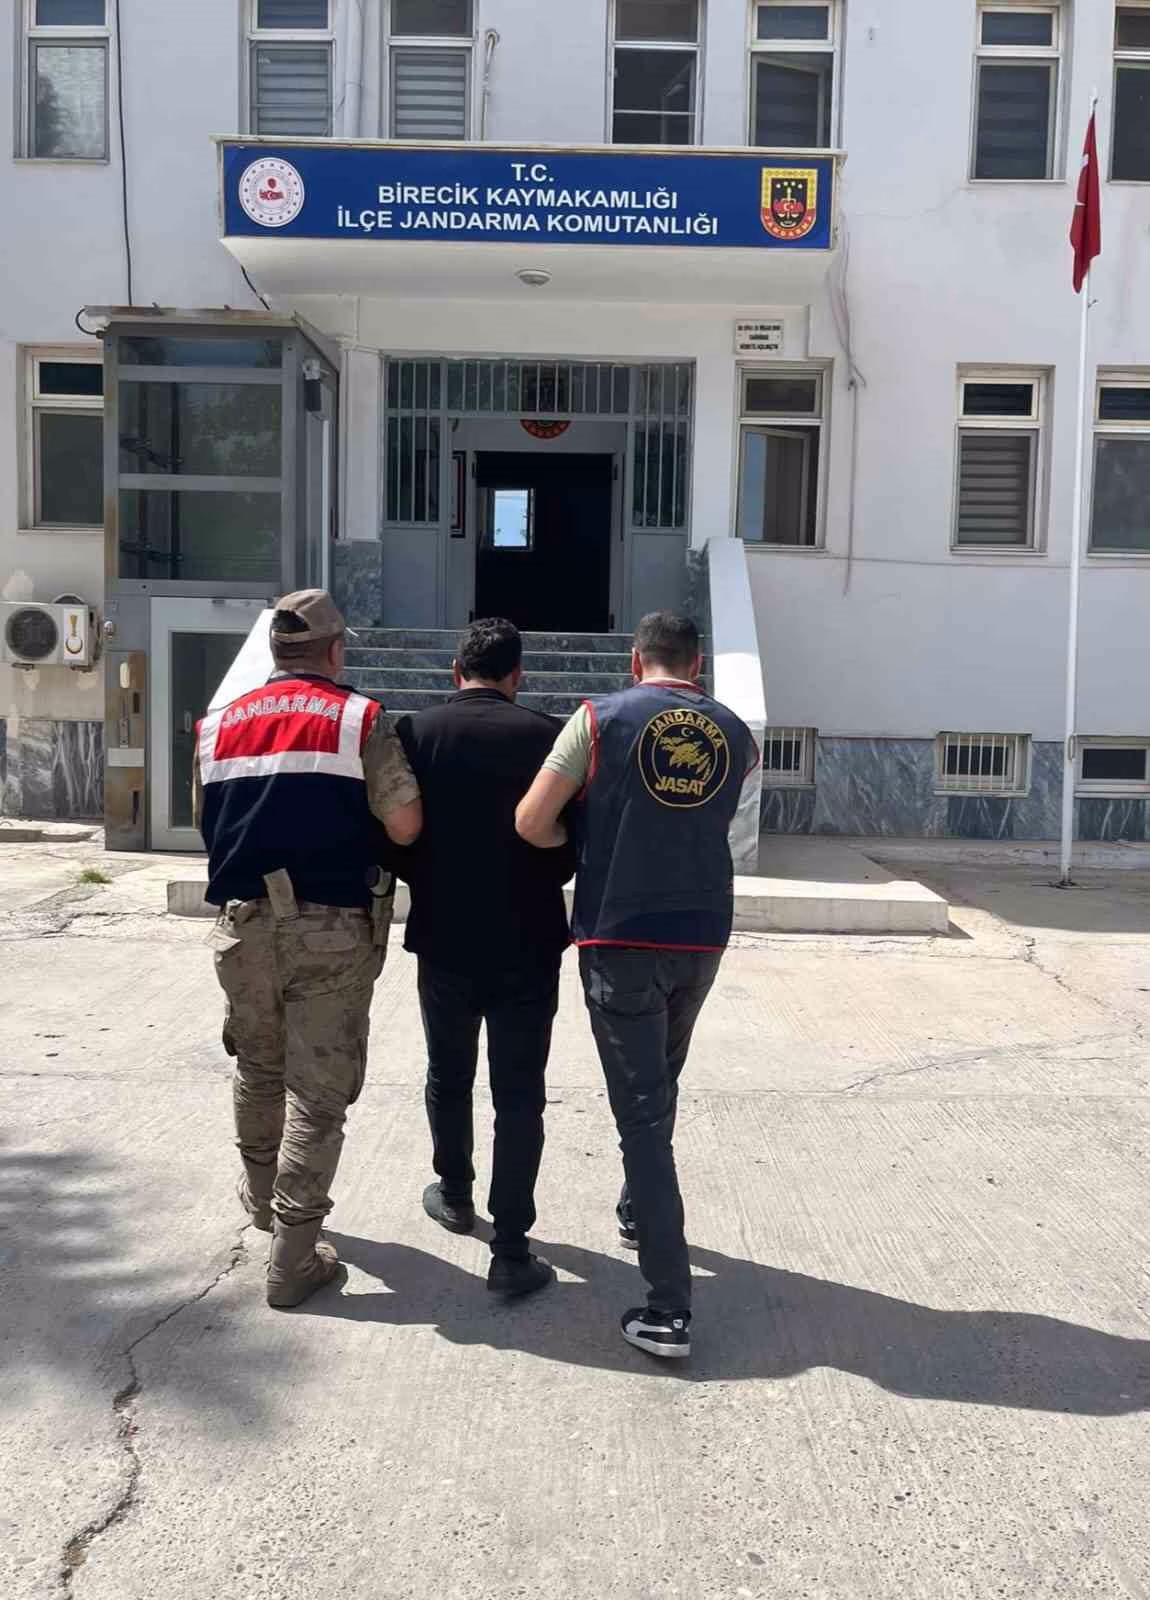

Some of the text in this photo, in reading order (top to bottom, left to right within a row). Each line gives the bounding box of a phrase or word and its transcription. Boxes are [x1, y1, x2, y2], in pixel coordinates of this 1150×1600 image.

[511, 163, 554, 182] T.C.
[378, 182, 678, 209] BİRECİK KAYMAKAMLIĞI
[337, 205, 718, 235] İLÇE JANDARMA KOMUTANLIĞI
[222, 695, 340, 728] JANDARMA
[649, 712, 724, 749] JANDARMA
[655, 776, 705, 796] JASAT
